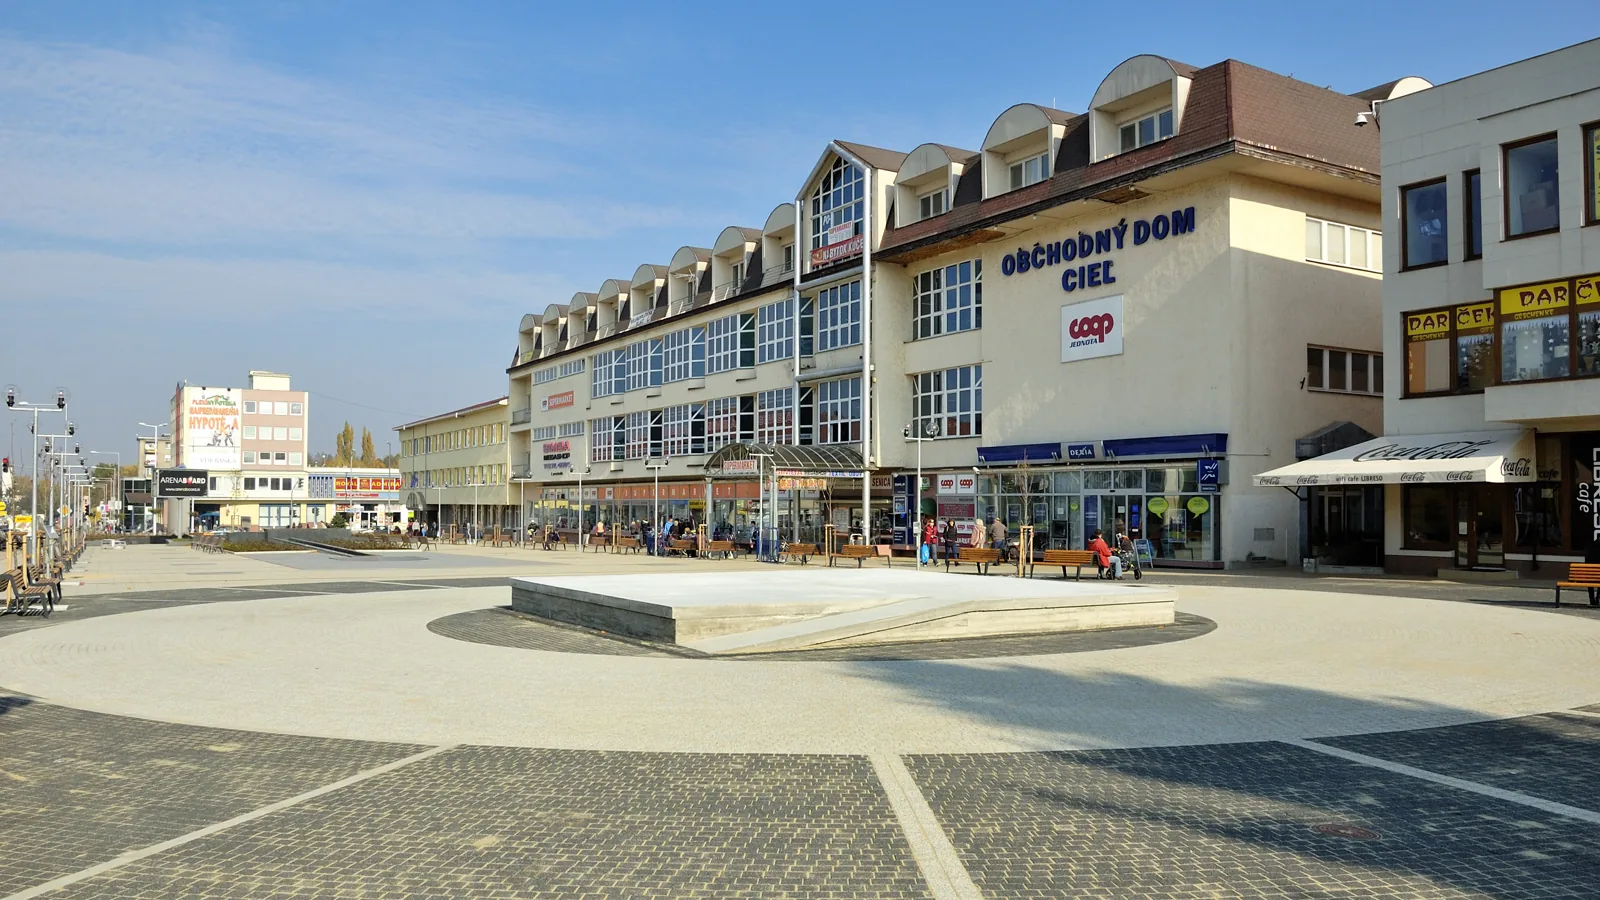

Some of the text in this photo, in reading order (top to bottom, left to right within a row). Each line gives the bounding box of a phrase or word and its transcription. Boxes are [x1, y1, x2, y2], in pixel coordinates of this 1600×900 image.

[1001, 206, 1196, 276] OBCHODNÝ DOM
[1061, 260, 1116, 292] CIEĽ
[1513, 309, 1555, 320] GESCHENKE
[1412, 332, 1446, 341] GESCHENKE
[1069, 338, 1098, 348] JEDNOTA
[1070, 447, 1092, 457] DEXIA
[724, 460, 755, 470] SUPERMARKET
[1538, 469, 1559, 479] cafe
[872, 477, 890, 486] SENICA
[1576, 482, 1593, 513] cafe
